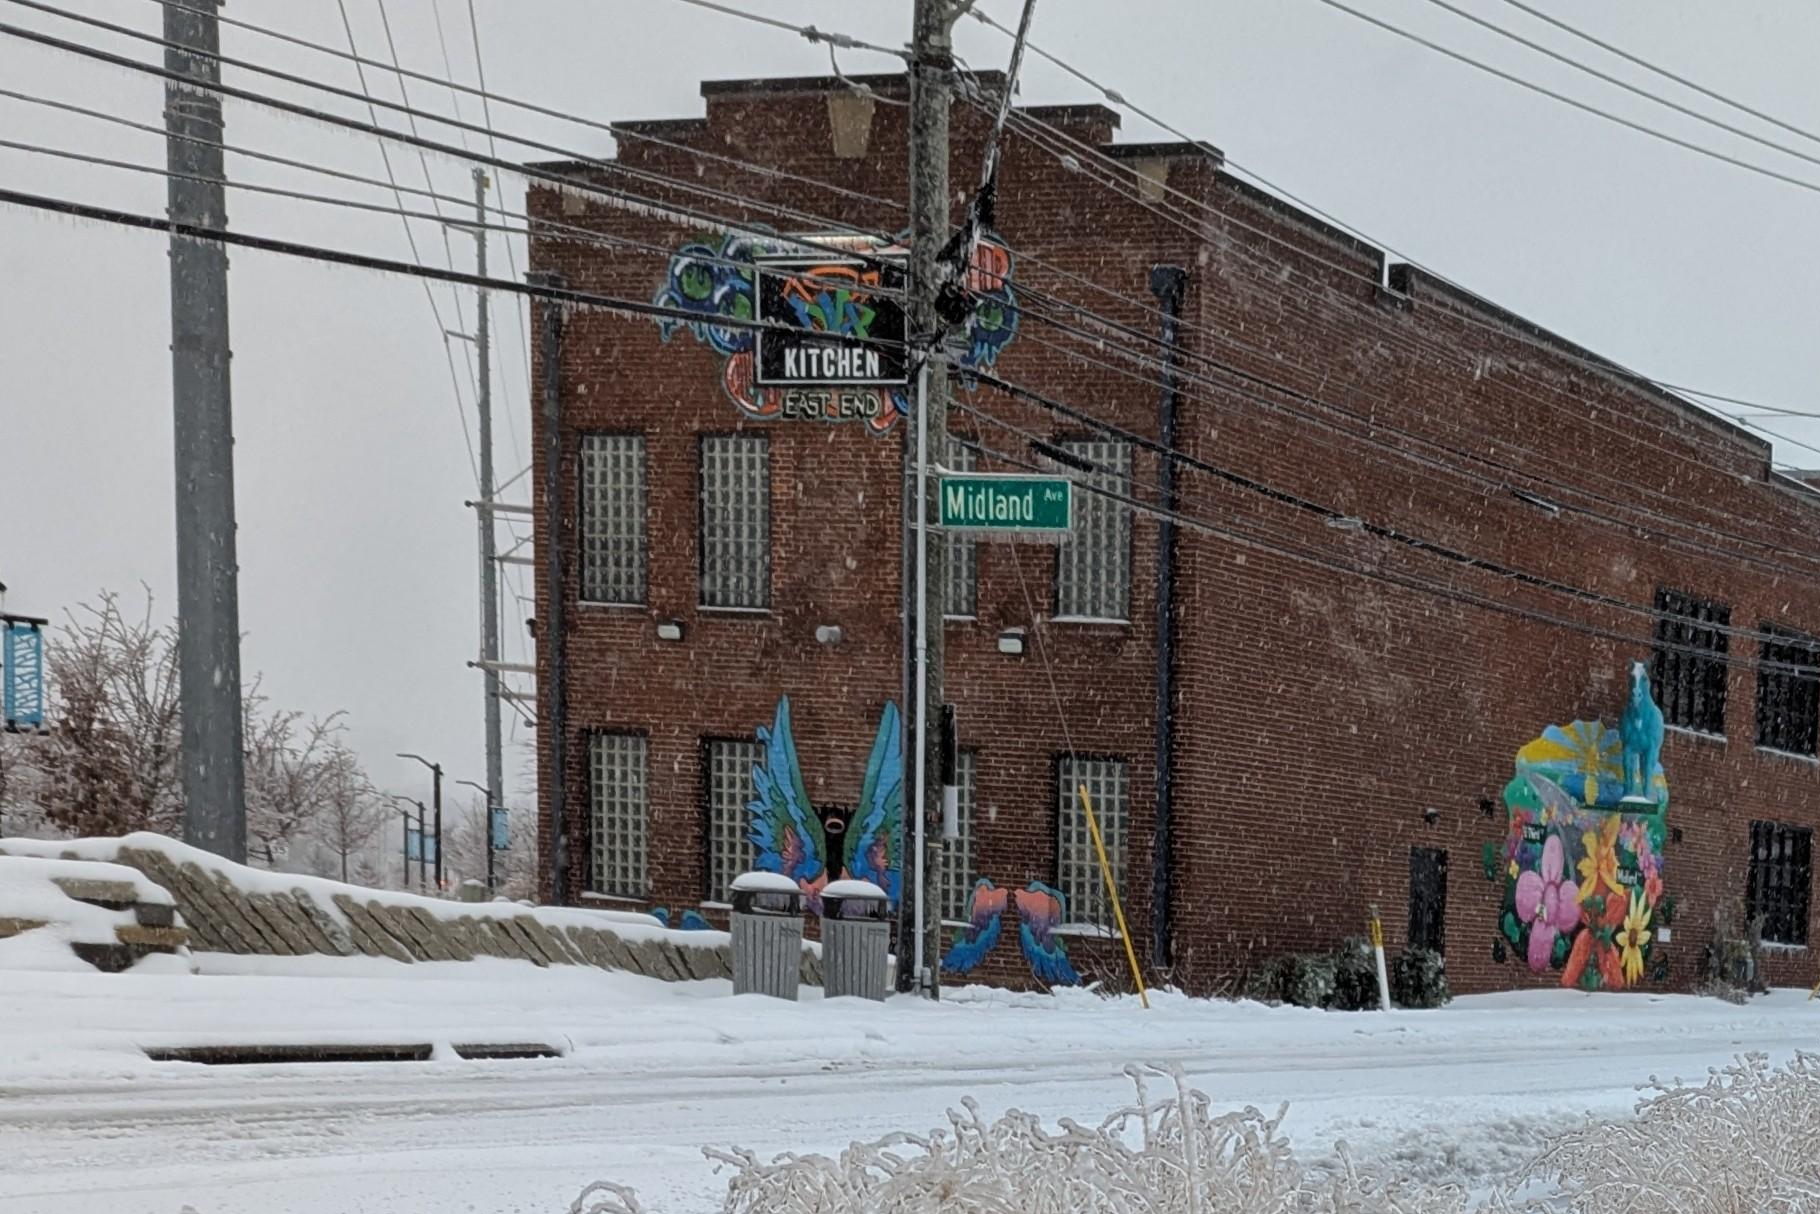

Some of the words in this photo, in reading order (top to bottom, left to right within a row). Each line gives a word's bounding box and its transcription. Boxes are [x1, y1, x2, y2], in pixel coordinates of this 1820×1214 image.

[784, 346, 880, 378] KITCHEN
[783, 391, 831, 419] EAST
[839, 391, 881, 419] END
[946, 485, 1034, 521] Midland
[1043, 487, 1065, 502] Ave
